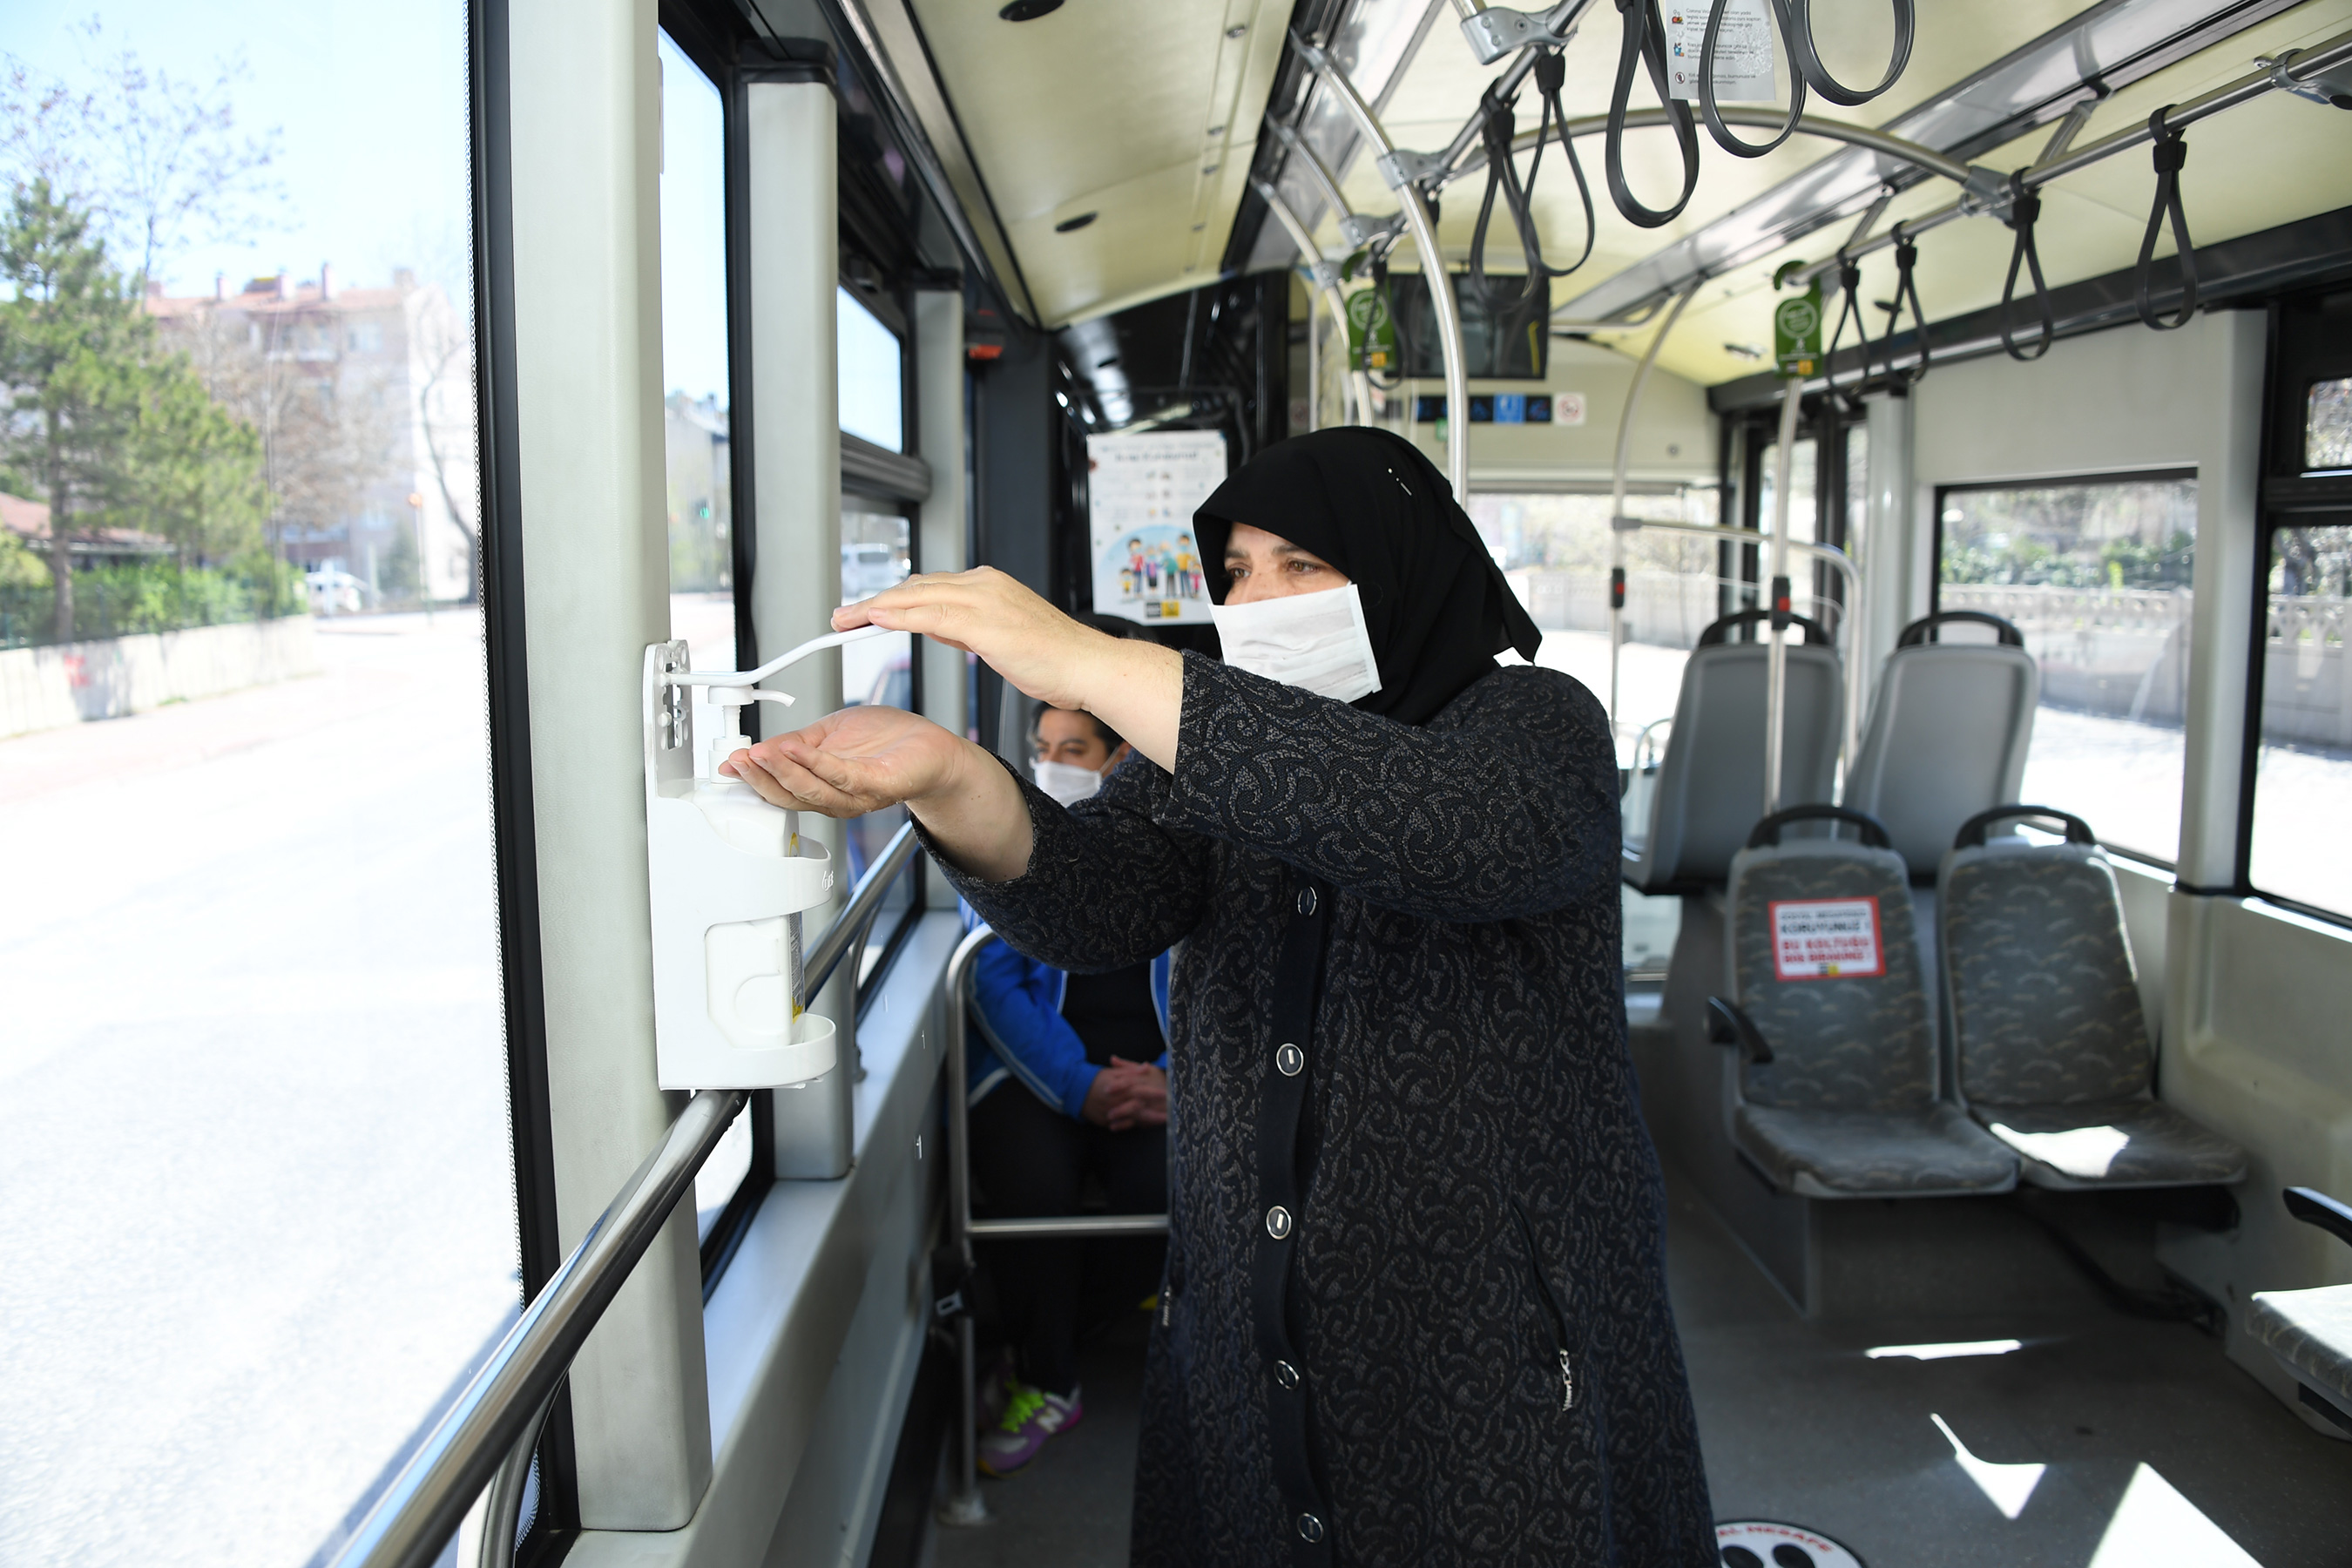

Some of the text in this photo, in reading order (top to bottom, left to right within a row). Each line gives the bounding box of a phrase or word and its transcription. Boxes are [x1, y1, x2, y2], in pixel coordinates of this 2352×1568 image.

[1781, 922, 1861, 935] KORUYUNUZ
[1783, 941, 1800, 950] BU
[1747, 1524, 1833, 1553] MESAFE
